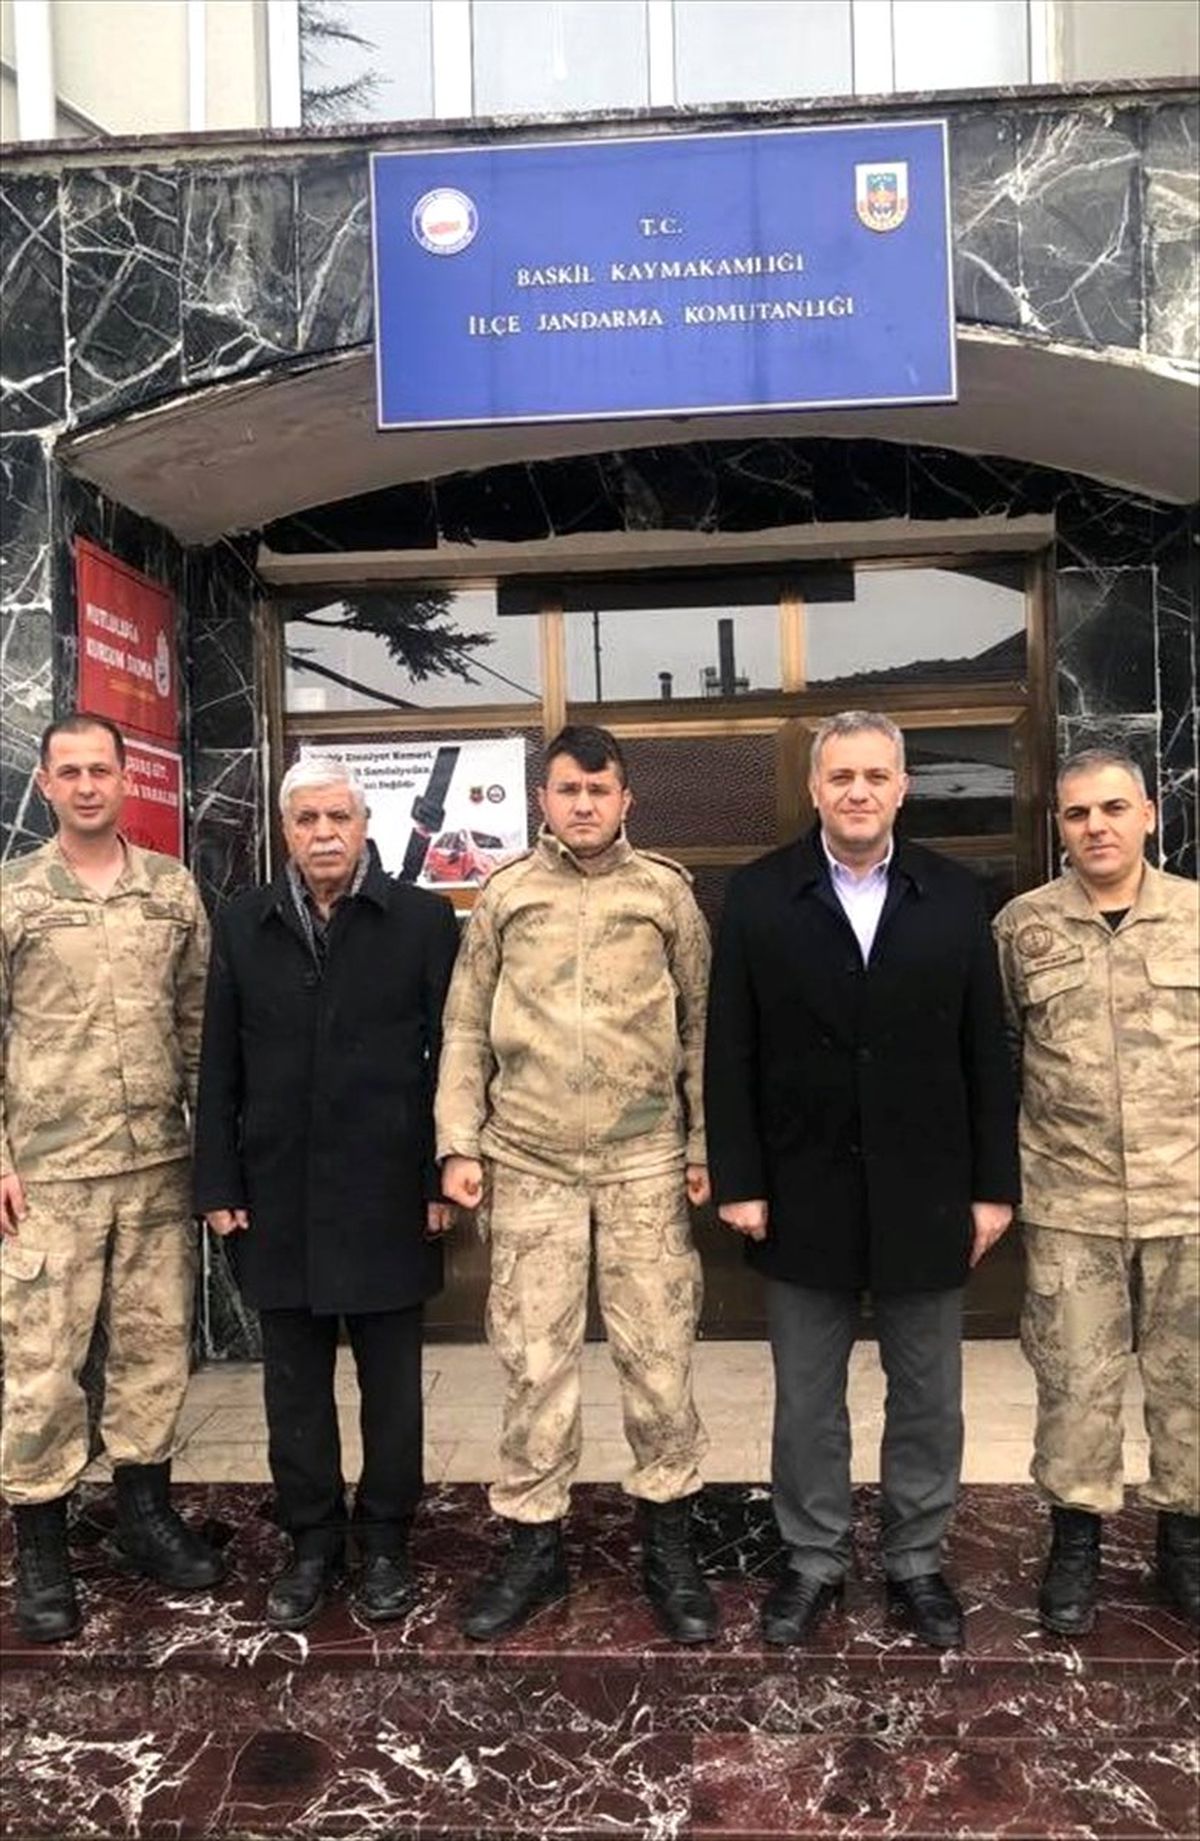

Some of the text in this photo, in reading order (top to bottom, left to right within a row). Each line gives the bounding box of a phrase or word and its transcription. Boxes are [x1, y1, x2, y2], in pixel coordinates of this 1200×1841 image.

[640, 217, 683, 236] T.C.
[516, 252, 804, 287] BASKİL KAYMAKAMLIĞI
[468, 295, 854, 336] İLÇE JANDARMA KOMUTANLIĞI
